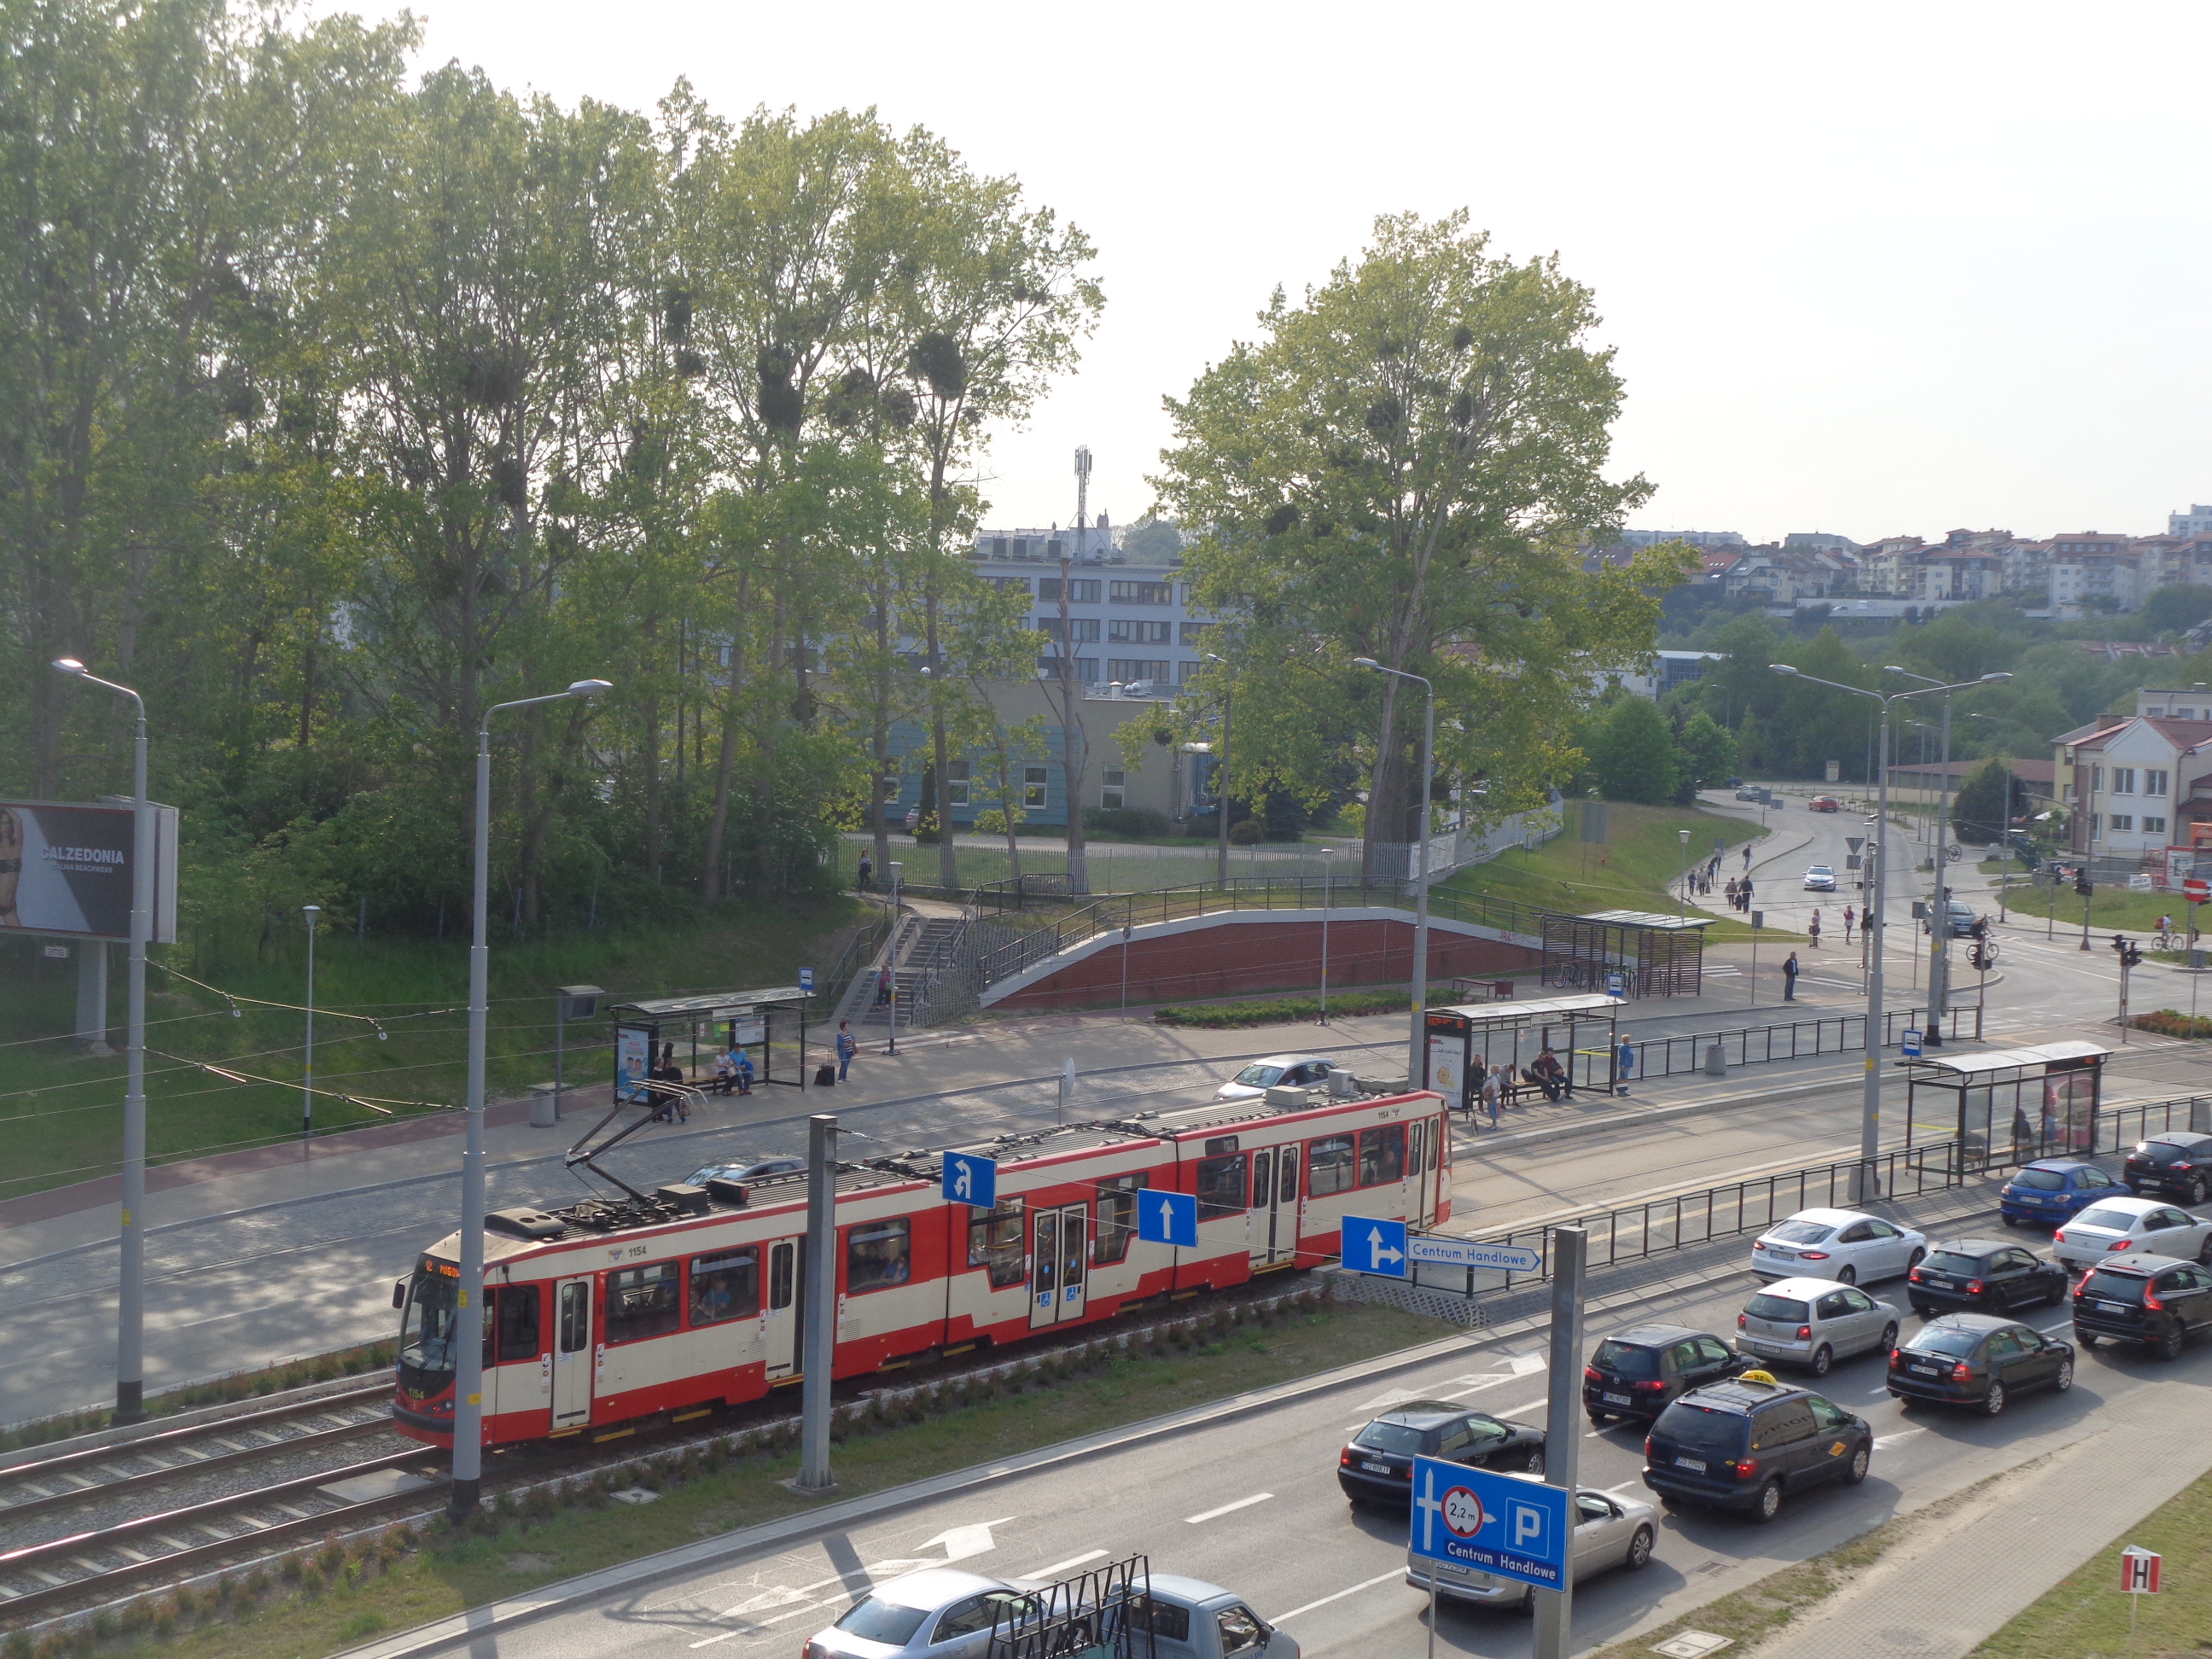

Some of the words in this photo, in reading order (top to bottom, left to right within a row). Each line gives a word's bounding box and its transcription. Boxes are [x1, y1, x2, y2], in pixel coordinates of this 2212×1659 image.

[42, 847, 125, 864] CALZEDONIA
[52, 863, 74, 871] ITALIAN
[75, 864, 114, 874] BEACHWEAR
[1377, 1110, 1389, 1119] 1154
[628, 1246, 647, 1258] 1154
[1412, 1243, 1462, 1259] Centrum
[1467, 1249, 1527, 1266] Handlowe
[408, 1387, 424, 1400] 1154
[1450, 1503, 1465, 1518] 2,2
[1515, 1505, 1540, 1545] P
[1447, 1542, 1493, 1564] Centrum
[1500, 1554, 1556, 1580] Handlowe
[2132, 1559, 2149, 1588] H
